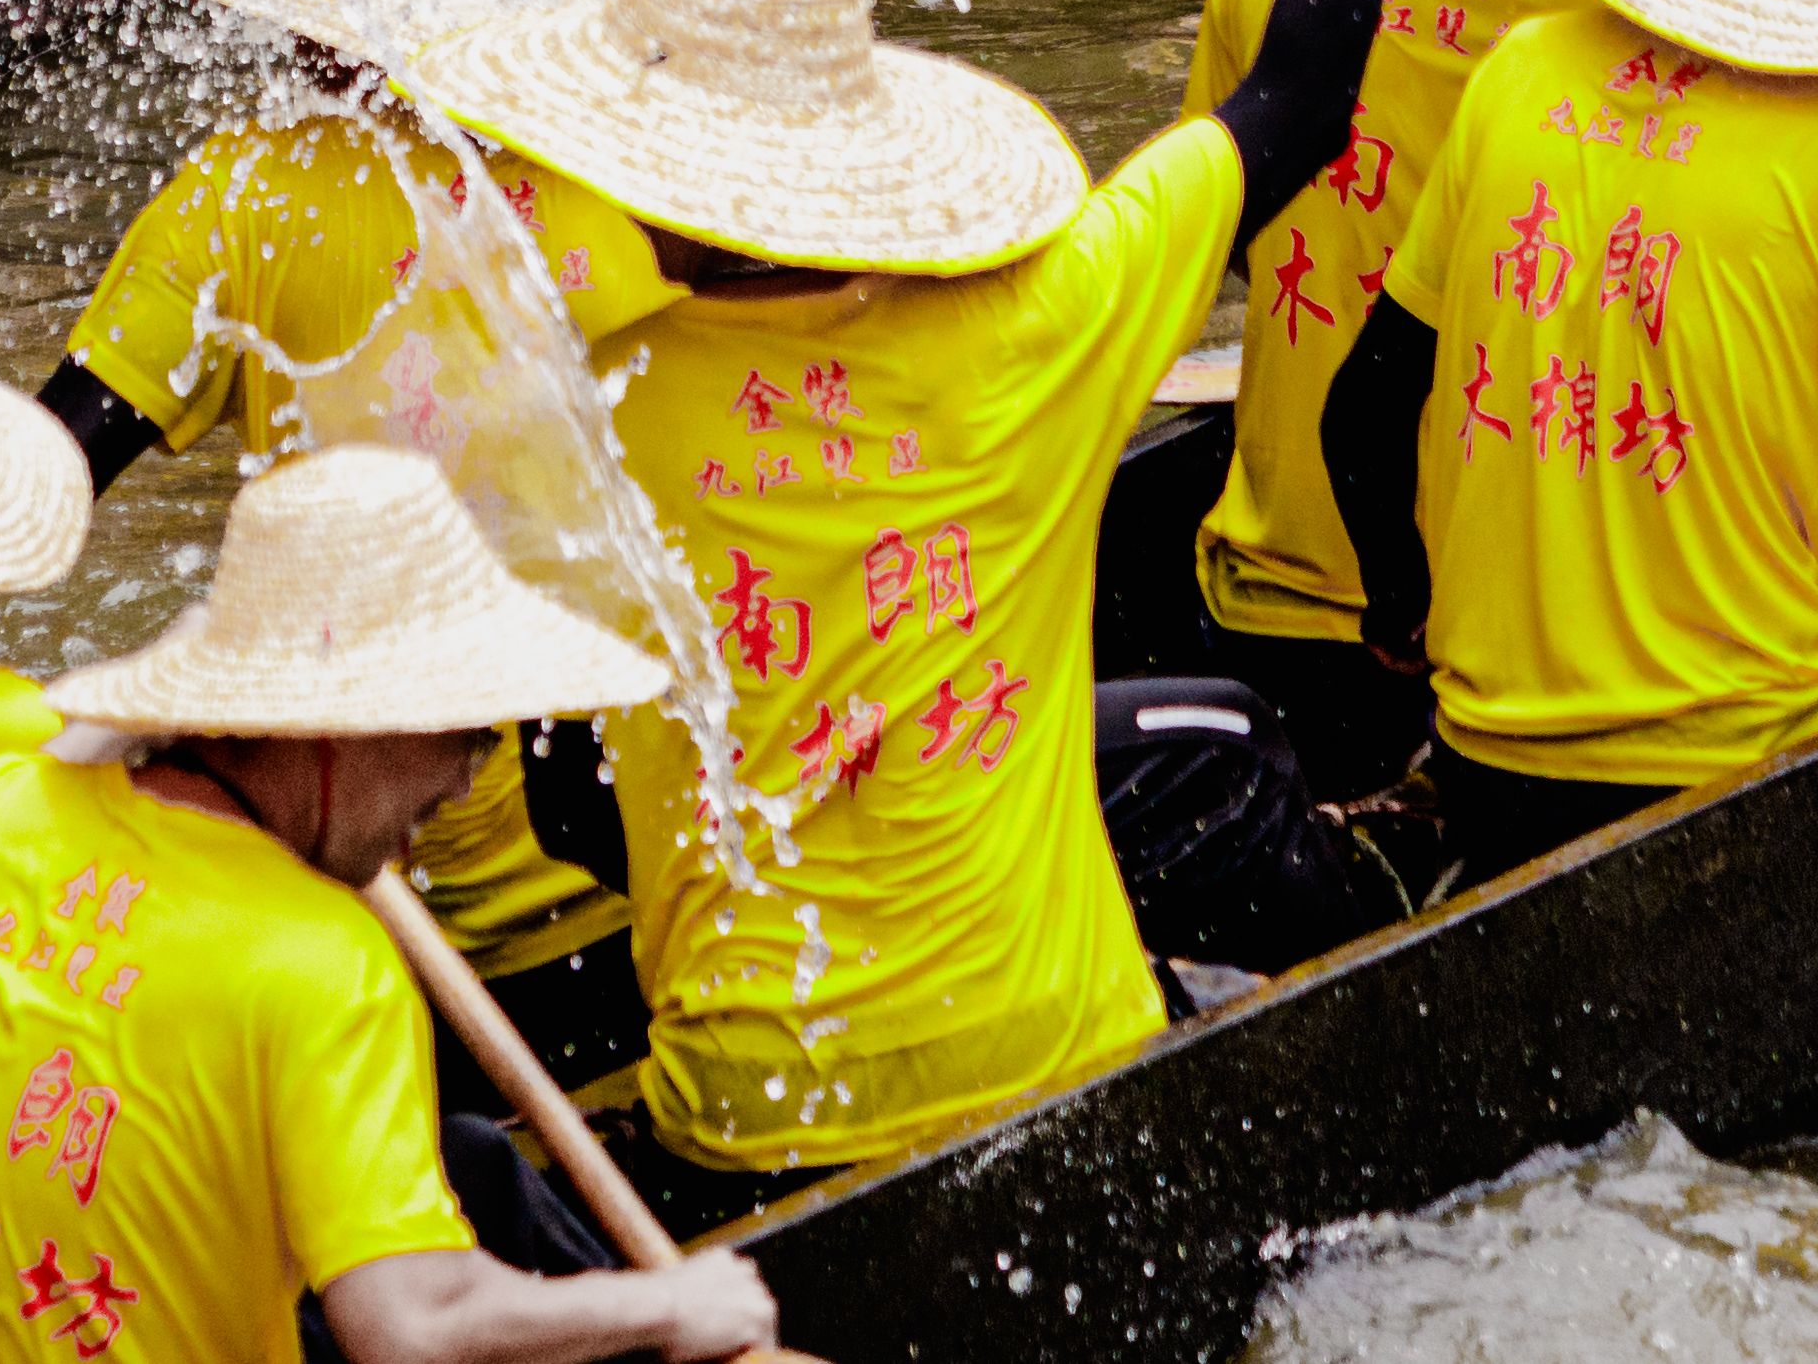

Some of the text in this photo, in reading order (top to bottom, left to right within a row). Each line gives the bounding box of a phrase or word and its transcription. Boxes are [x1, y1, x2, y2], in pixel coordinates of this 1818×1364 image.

[1492, 179, 1682, 349] 南朗
[729, 357, 865, 434] 金裝
[1458, 342, 1695, 497] 木棉坊
[712, 522, 979, 684] 南朗
